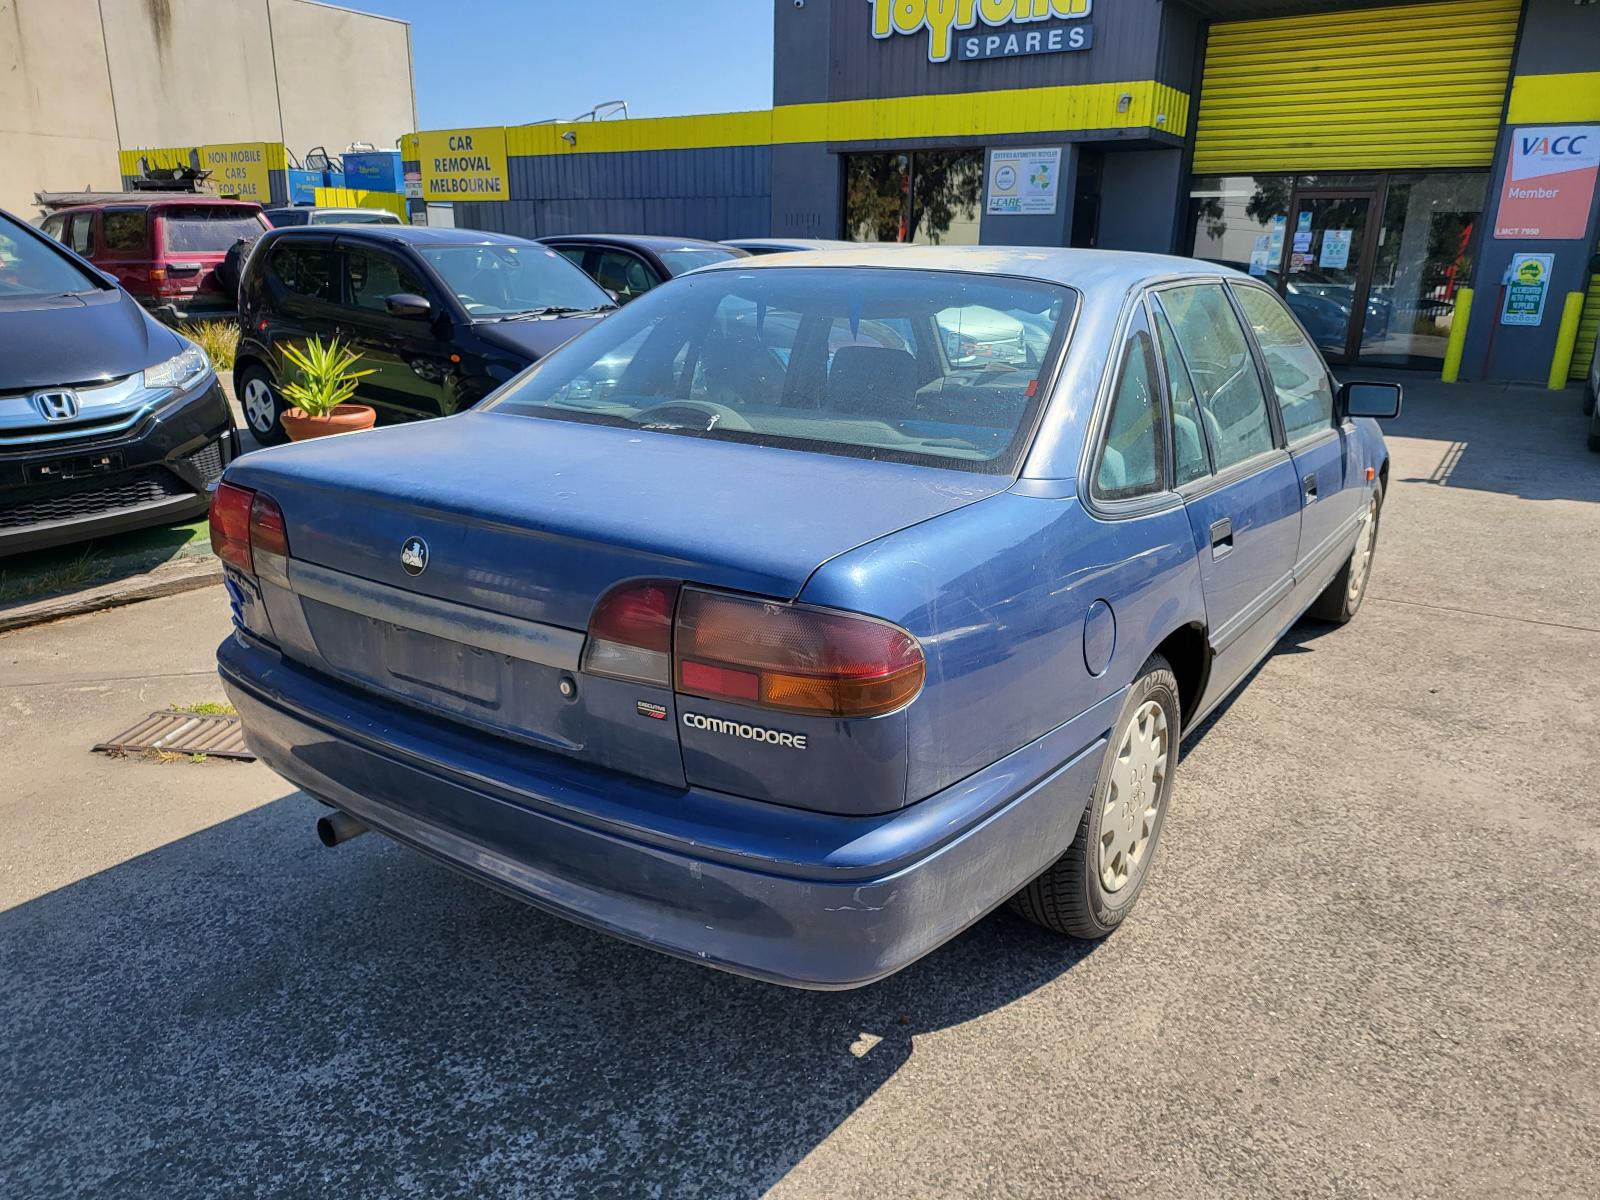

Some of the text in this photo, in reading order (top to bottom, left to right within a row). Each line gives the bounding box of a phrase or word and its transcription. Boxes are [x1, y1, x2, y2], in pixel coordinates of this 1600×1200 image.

[965, 27, 1085, 58] SPARES
[448, 135, 473, 151] CAR
[1522, 135, 1588, 156] VACC
[208, 150, 261, 163] NON MOBILE
[434, 156, 491, 172] REMOVAL
[225, 167, 247, 179] CARS
[218, 183, 257, 195] FOR SALE
[430, 177, 501, 193] MELBOURNE
[1508, 187, 1559, 199] Member
[637, 701, 666, 712] EXECUTIVE
[682, 712, 808, 750] COMMODORE
